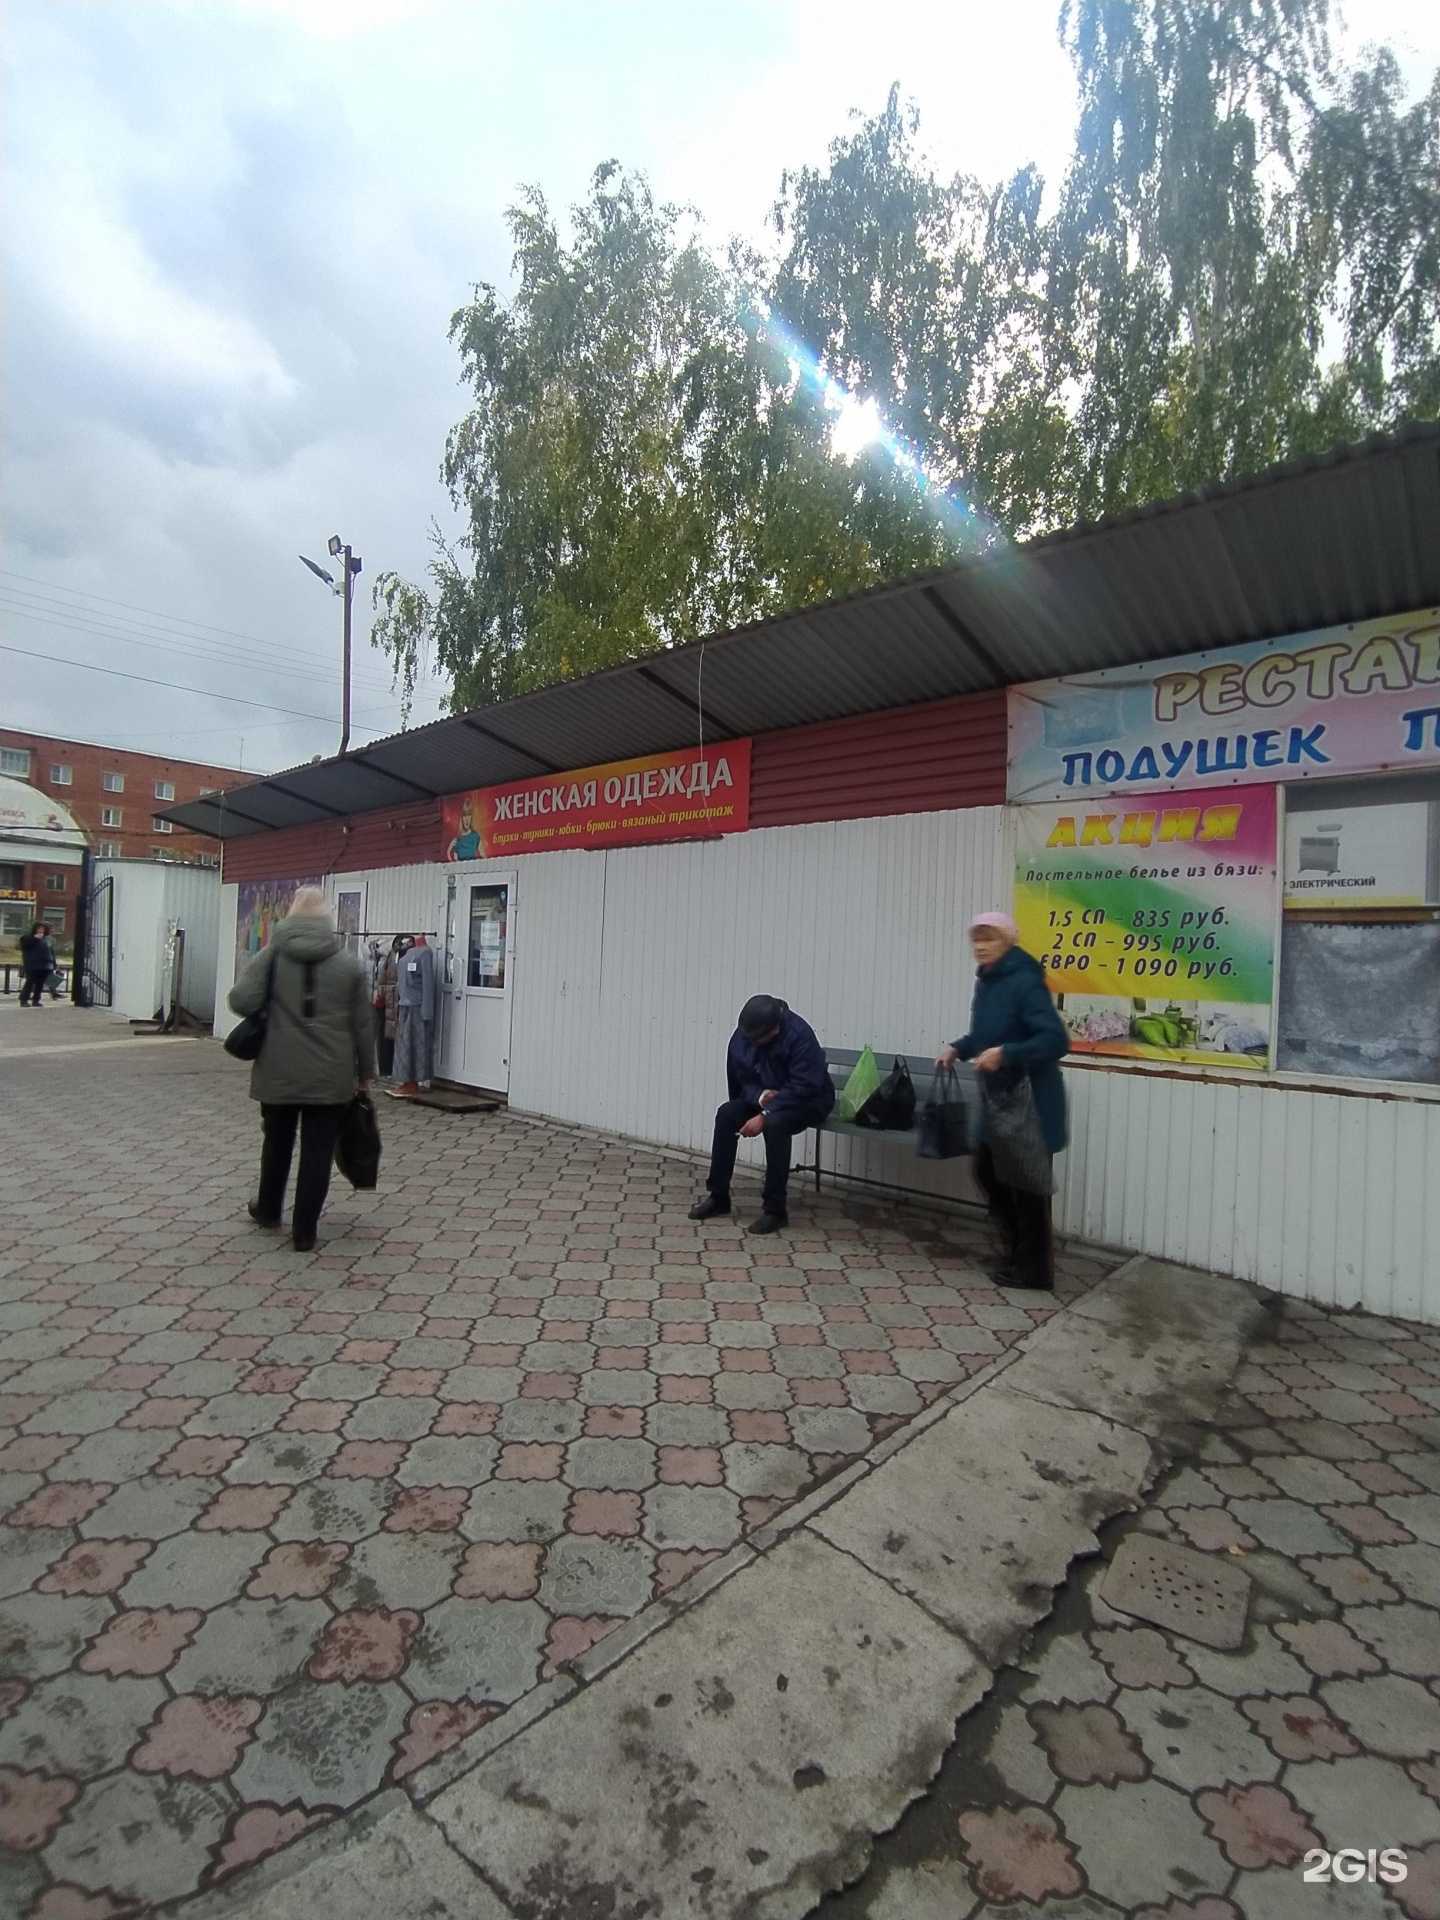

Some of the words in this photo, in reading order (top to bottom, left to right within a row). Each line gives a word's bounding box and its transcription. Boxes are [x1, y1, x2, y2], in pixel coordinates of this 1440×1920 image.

[1062, 724, 1331, 785] ПОДУШЕК
[493, 780, 598, 822] ЖЕНСКАЯ
[603, 757, 734, 809] ОДЕЖДА
[558, 823, 582, 836] юбки
[586, 819, 617, 836] брюки
[622, 812, 666, 828] вязаный
[668, 804, 734, 824] трикотаж
[1046, 804, 1243, 848] АКЦИЯ
[1025, 868, 1123, 882] Постельное
[1129, 864, 1180, 879] белье
[1186, 866, 1206, 878] из
[1213, 862, 1264, 877] бязи:
[1289, 875, 1376, 889] ЭЛЕКТРИЧЕСКИЙ
[1082, 909, 1106, 925] СП
[1132, 909, 1172, 928] 835
[1180, 906, 1230, 930] руб.
[1052, 932, 1064, 950] 2
[1072, 931, 1097, 948] СП
[1123, 934, 1163, 952] 995
[1171, 931, 1221, 954] руб.
[1187, 957, 1238, 979] руб.
